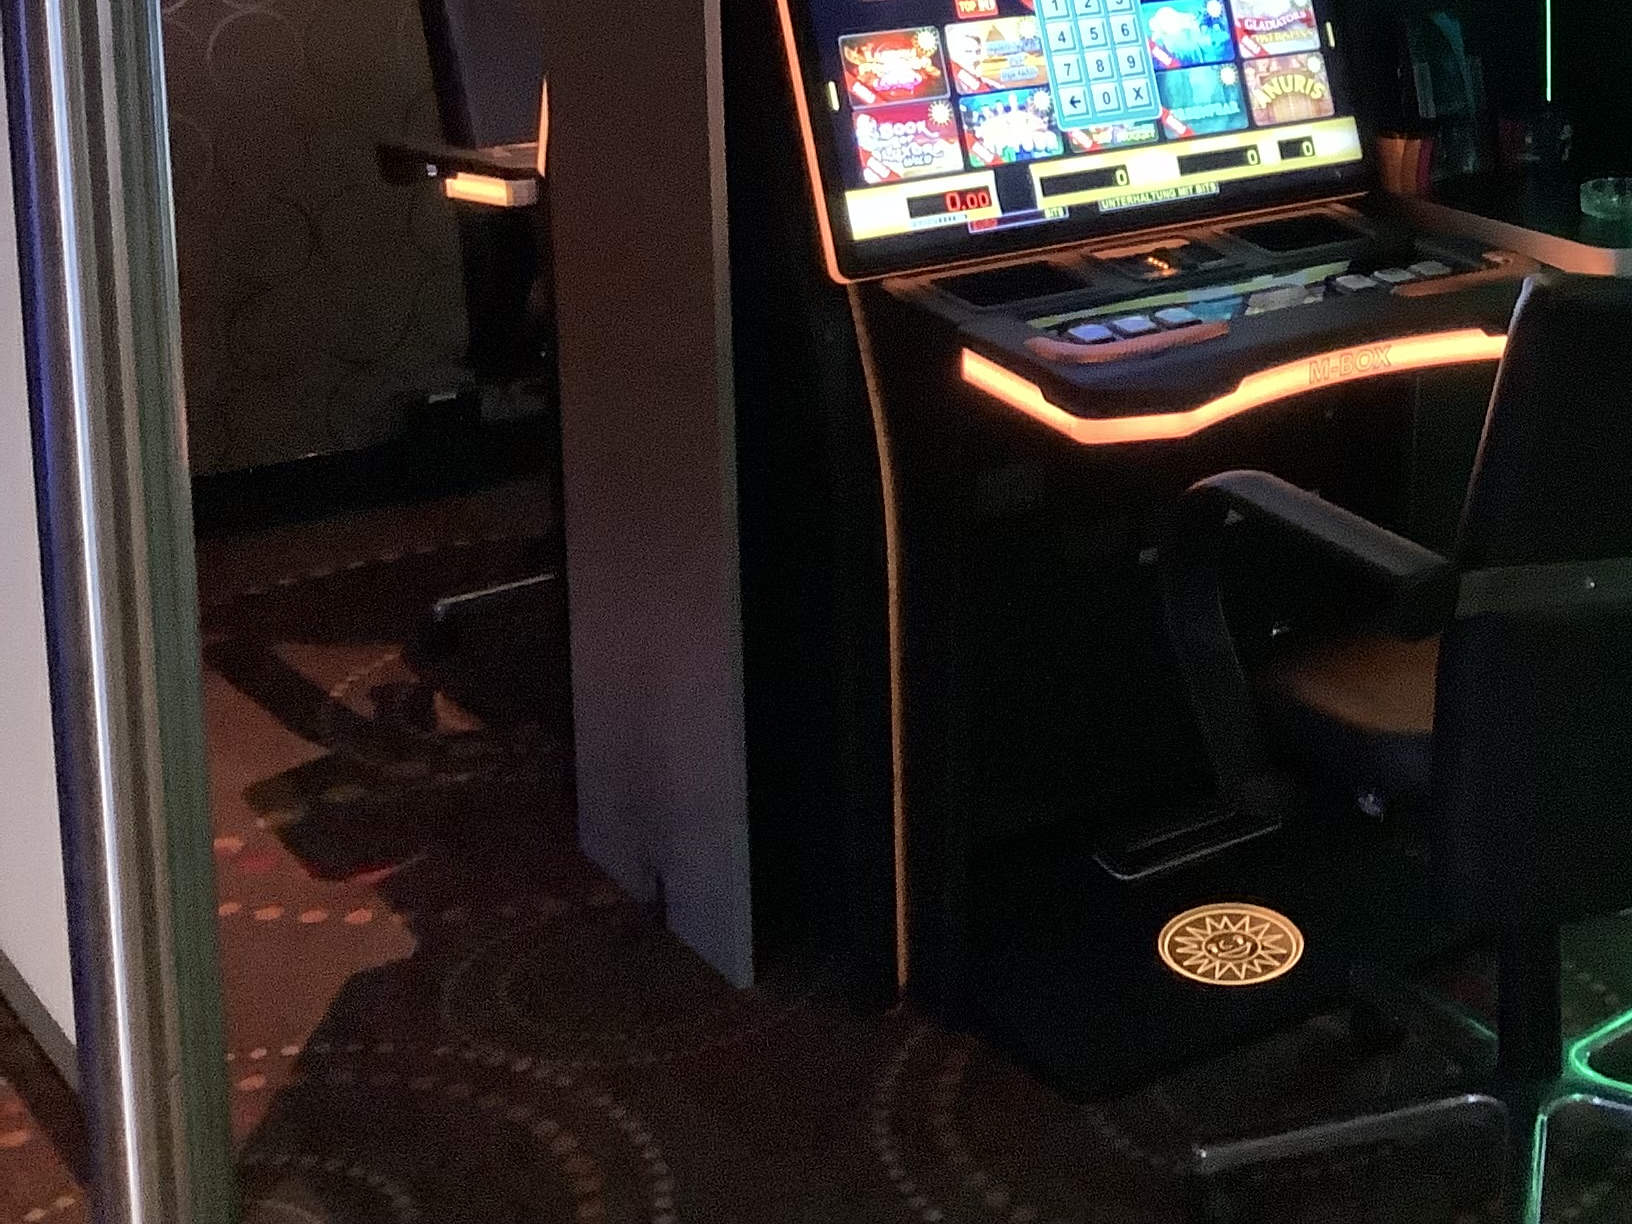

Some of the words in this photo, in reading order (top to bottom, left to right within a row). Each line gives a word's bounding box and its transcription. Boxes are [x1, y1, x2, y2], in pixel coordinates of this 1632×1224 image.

[958, 0, 976, 13] TOP
[1243, 11, 1307, 32] GLADIATORS
[1057, 31, 1066, 43] 4
[1090, 26, 1099, 40] 5
[1121, 23, 1130, 37] 6
[1252, 29, 1314, 44] OWERSPINS
[1063, 63, 1072, 76] 7
[1095, 59, 1104, 72] 8
[1127, 55, 1136, 68] 9
[1253, 74, 1326, 110] ANURIS
[945, 191, 990, 212] 0.00
[1101, 189, 1177, 209] UNTERHALTUNG
[1178, 186, 1195, 198] MIT
[1196, 183, 1217, 194] BITS
[1308, 344, 1392, 384] M-BOX
